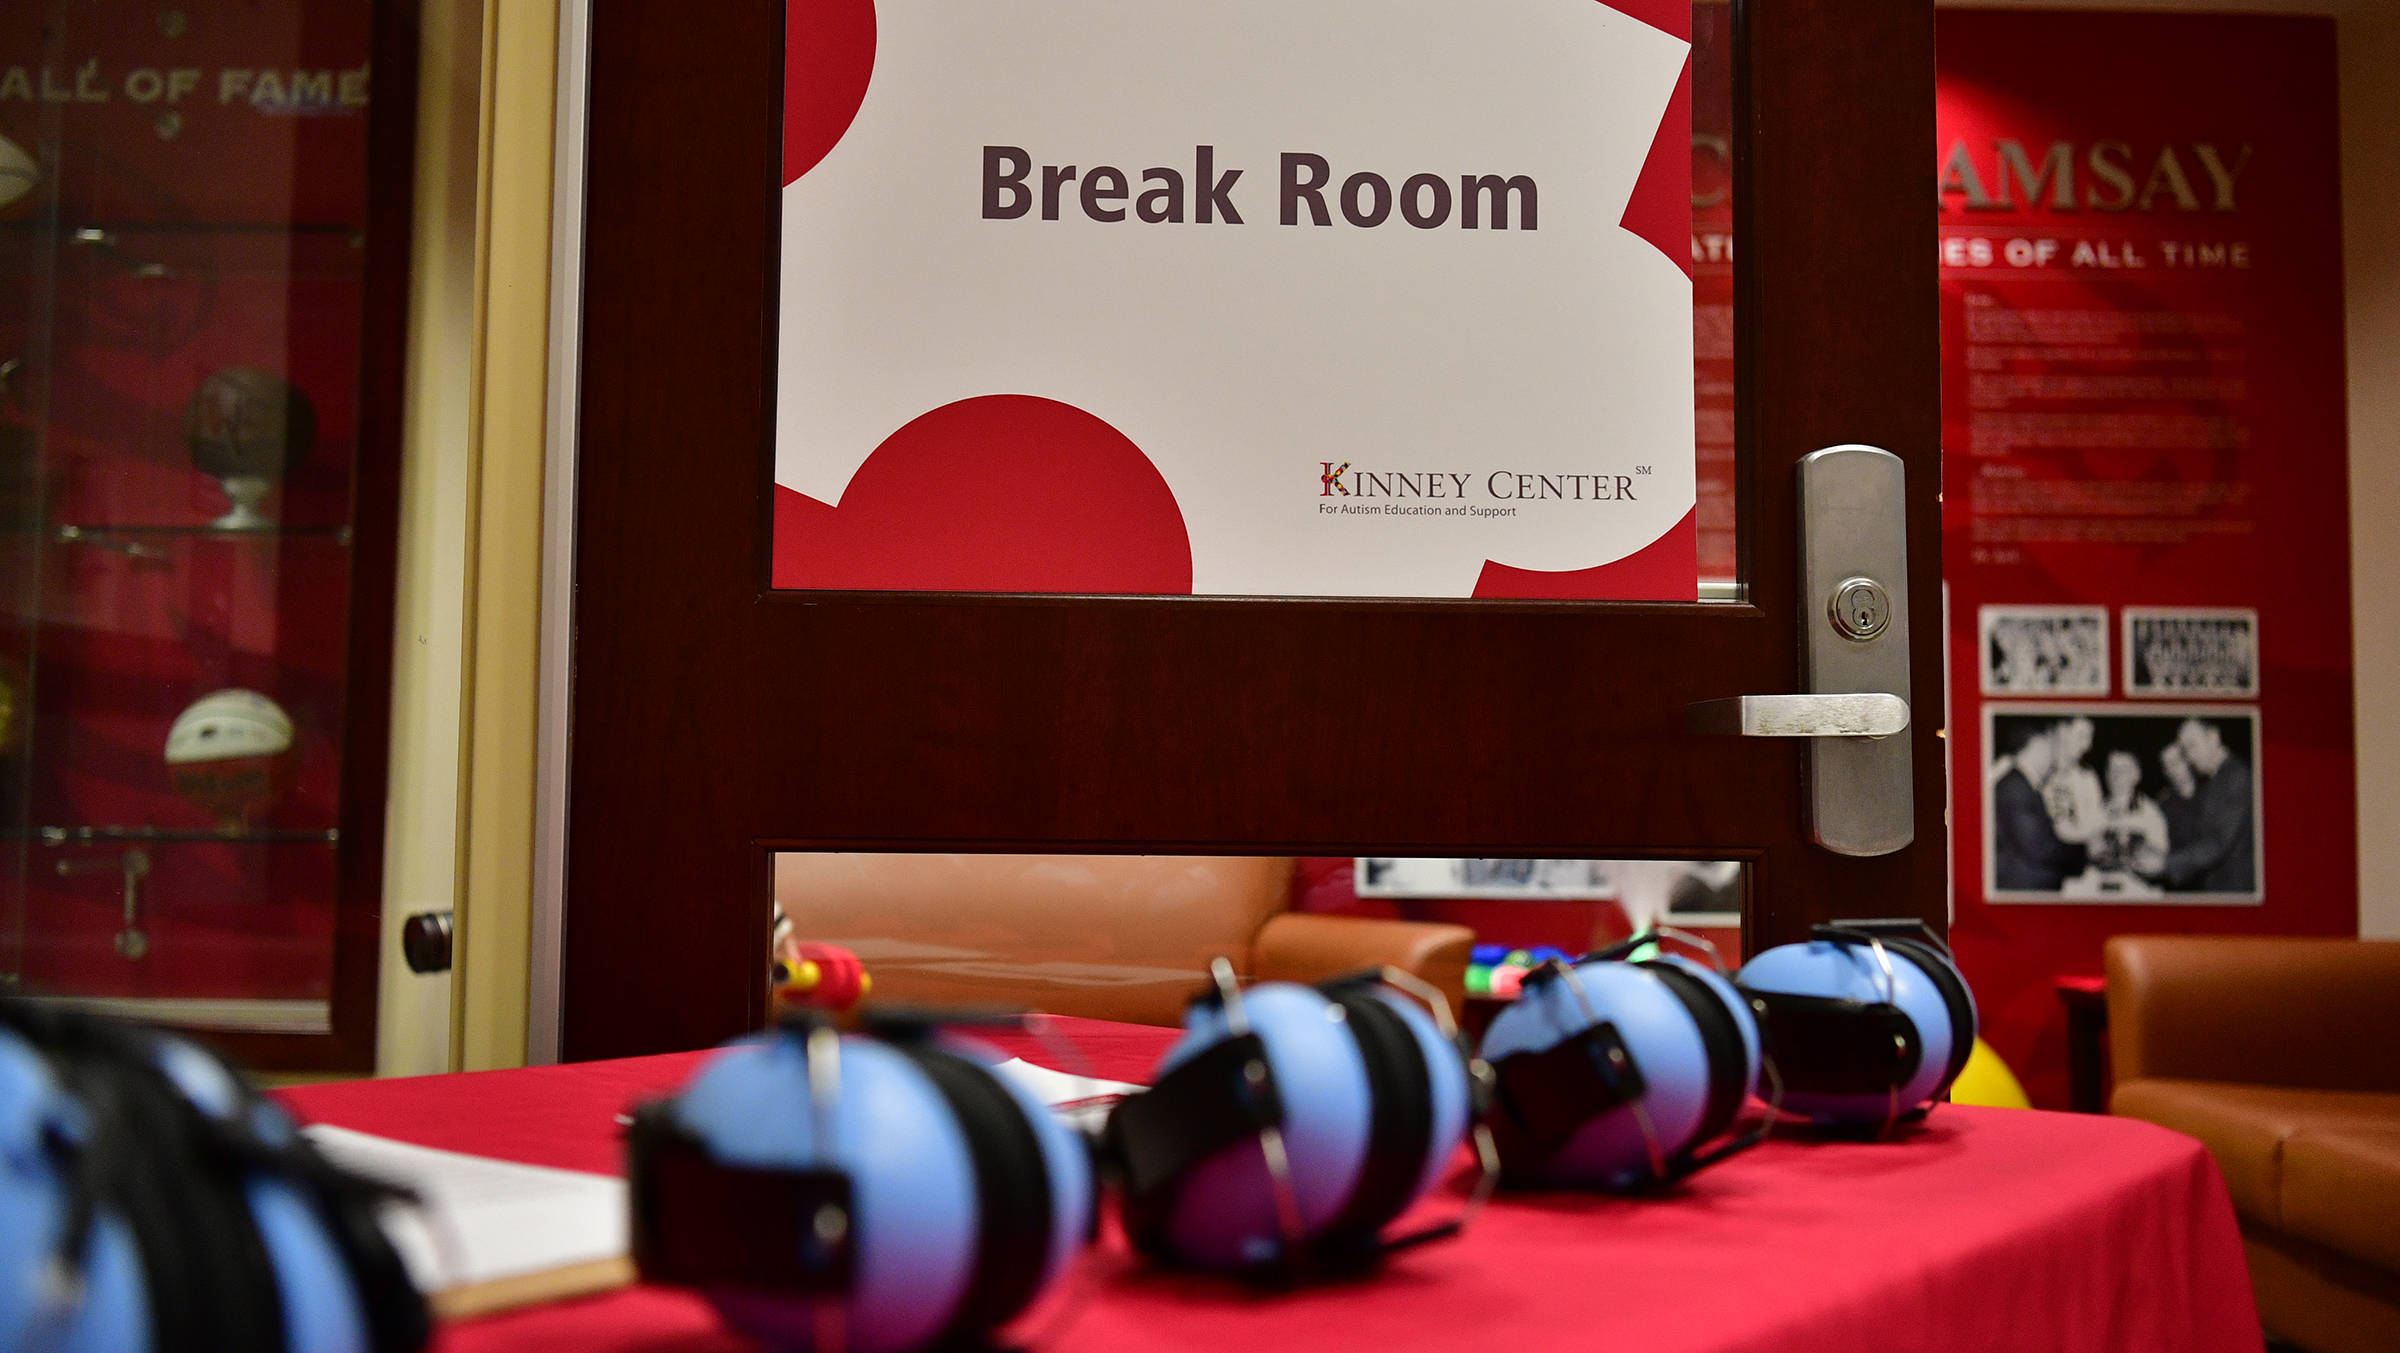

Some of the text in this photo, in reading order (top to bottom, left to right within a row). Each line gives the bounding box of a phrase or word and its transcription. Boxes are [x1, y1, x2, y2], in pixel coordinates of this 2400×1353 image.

[124, 67, 200, 102] OF
[219, 67, 369, 106] FAME
[981, 145, 1538, 231] Break Room
[1938, 237, 2251, 269] ES OF ALL TIME
[1319, 461, 1652, 501] KINNEY CENTER SM
[1319, 503, 1516, 519] For Autism Education and Support
